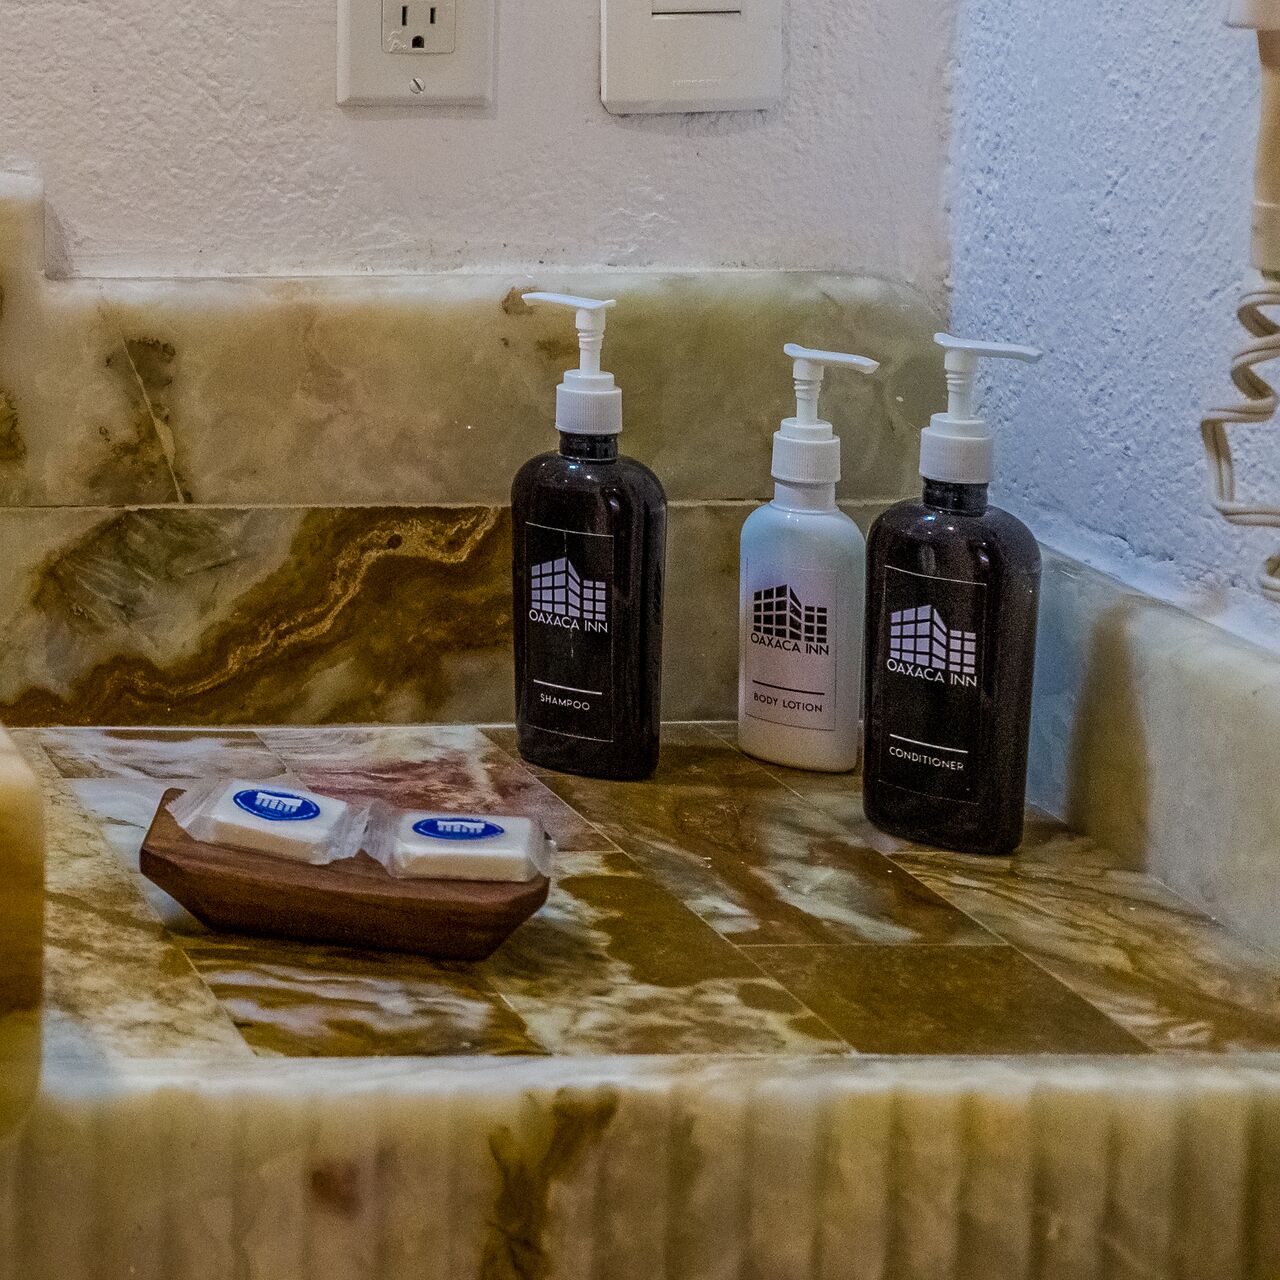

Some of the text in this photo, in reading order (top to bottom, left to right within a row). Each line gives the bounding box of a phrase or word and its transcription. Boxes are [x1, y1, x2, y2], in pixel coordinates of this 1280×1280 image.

[529, 609, 608, 633] OAXACA INN
[751, 633, 829, 656] OAXACA INN
[887, 659, 978, 687] OAXACA INN
[540, 693, 590, 711] SHAMPOO
[754, 692, 822, 712] BODY LOTION
[889, 746, 964, 771] CONDITIONER
